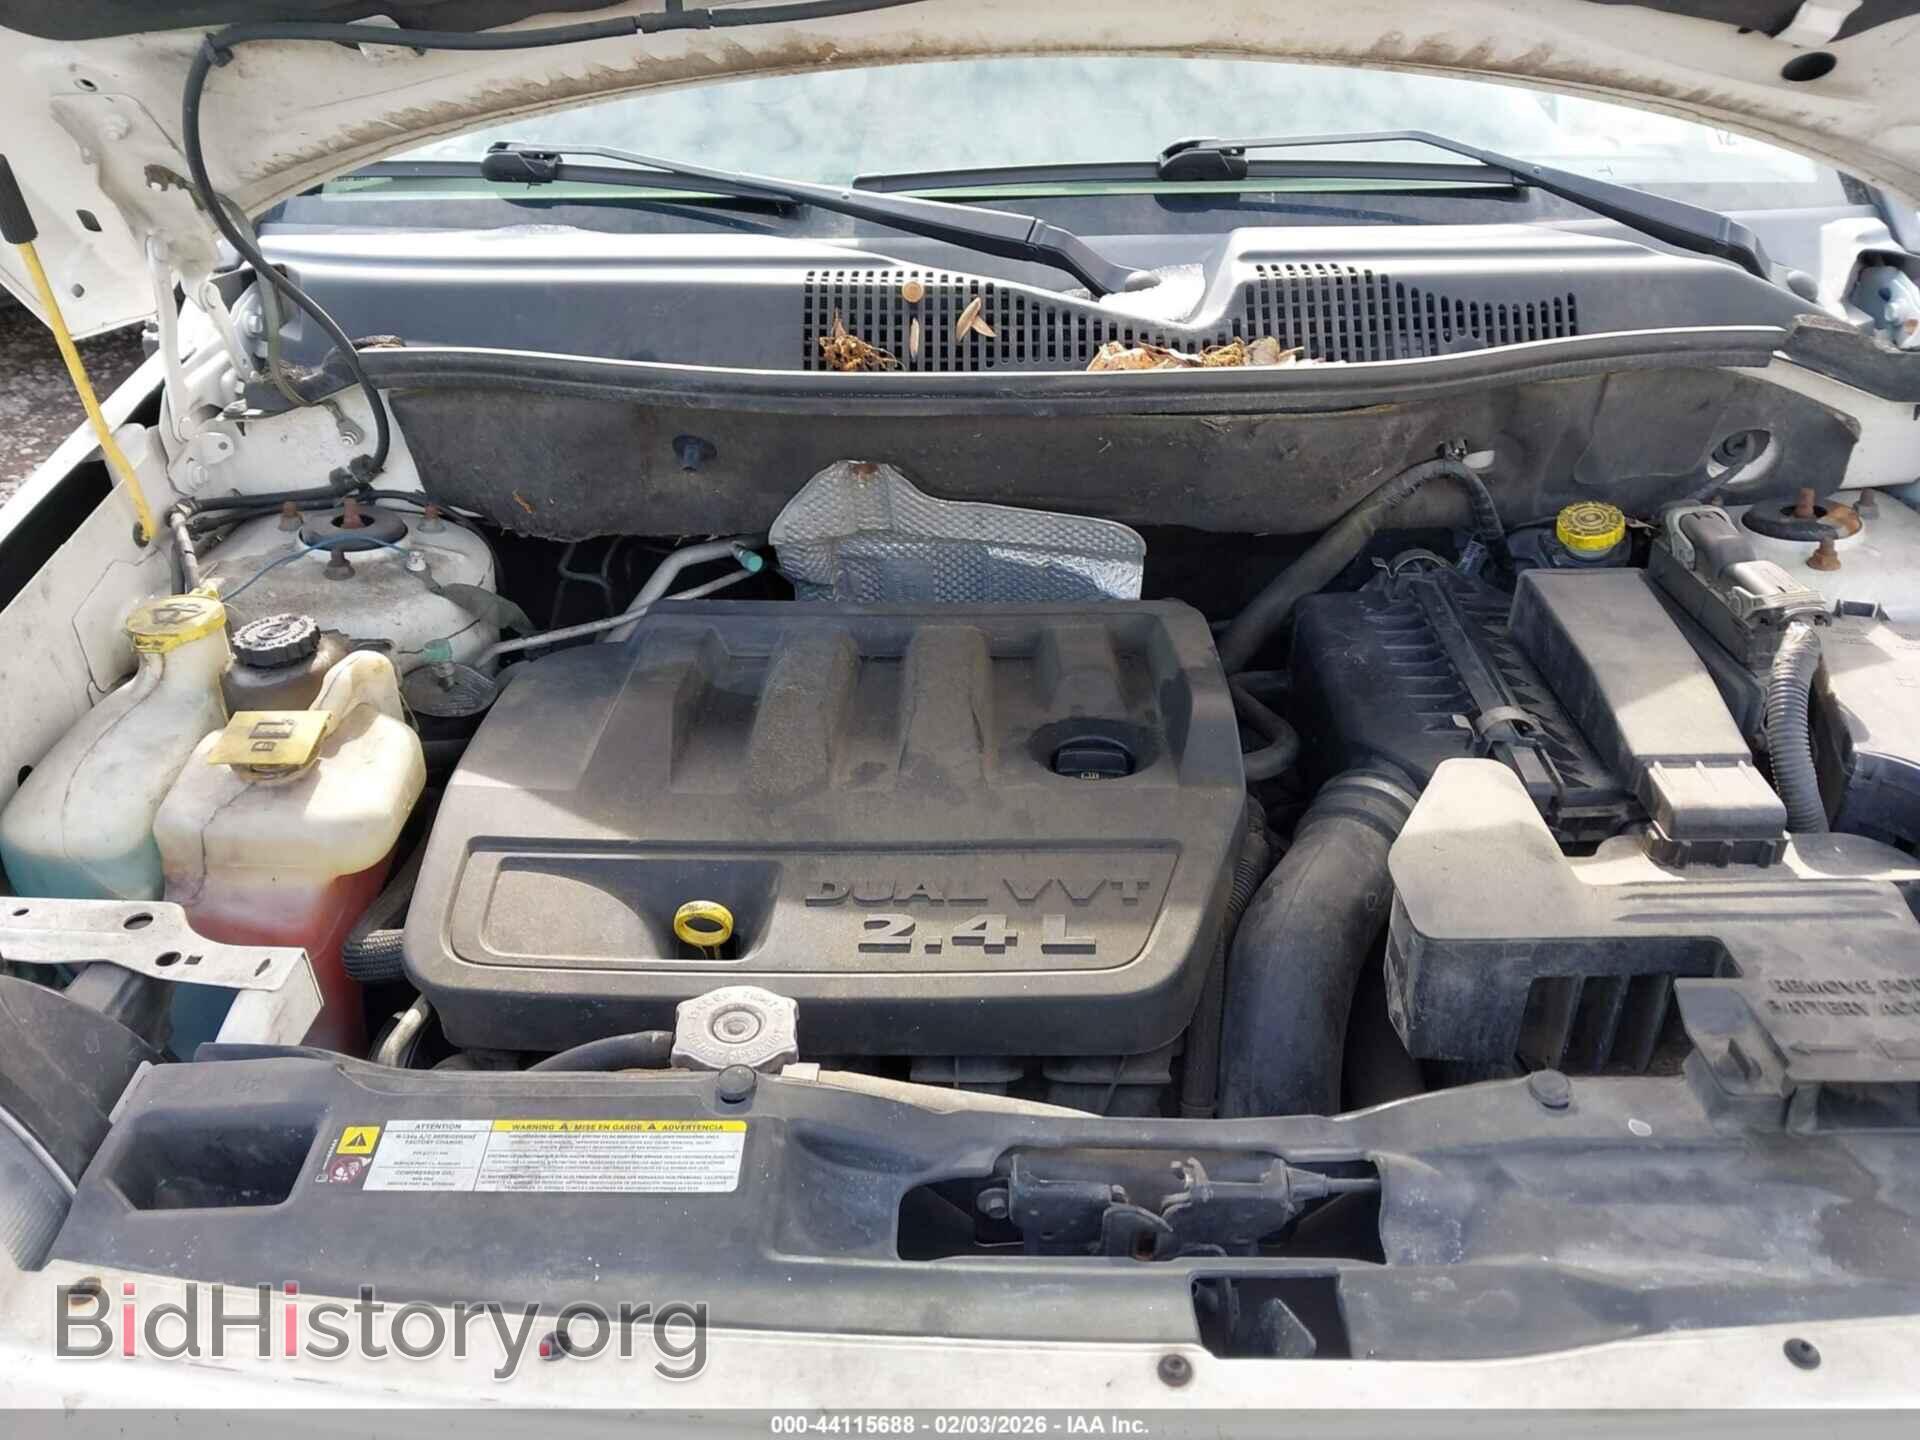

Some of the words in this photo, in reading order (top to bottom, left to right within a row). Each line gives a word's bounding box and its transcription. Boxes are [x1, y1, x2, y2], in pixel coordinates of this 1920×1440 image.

[805, 878, 989, 907] DUAL
[1002, 878, 1151, 907] VVT
[857, 914, 1097, 955] 2.4L
[1768, 979, 1877, 994] REMOVE
[1766, 1000, 1870, 1017] BATTERY
